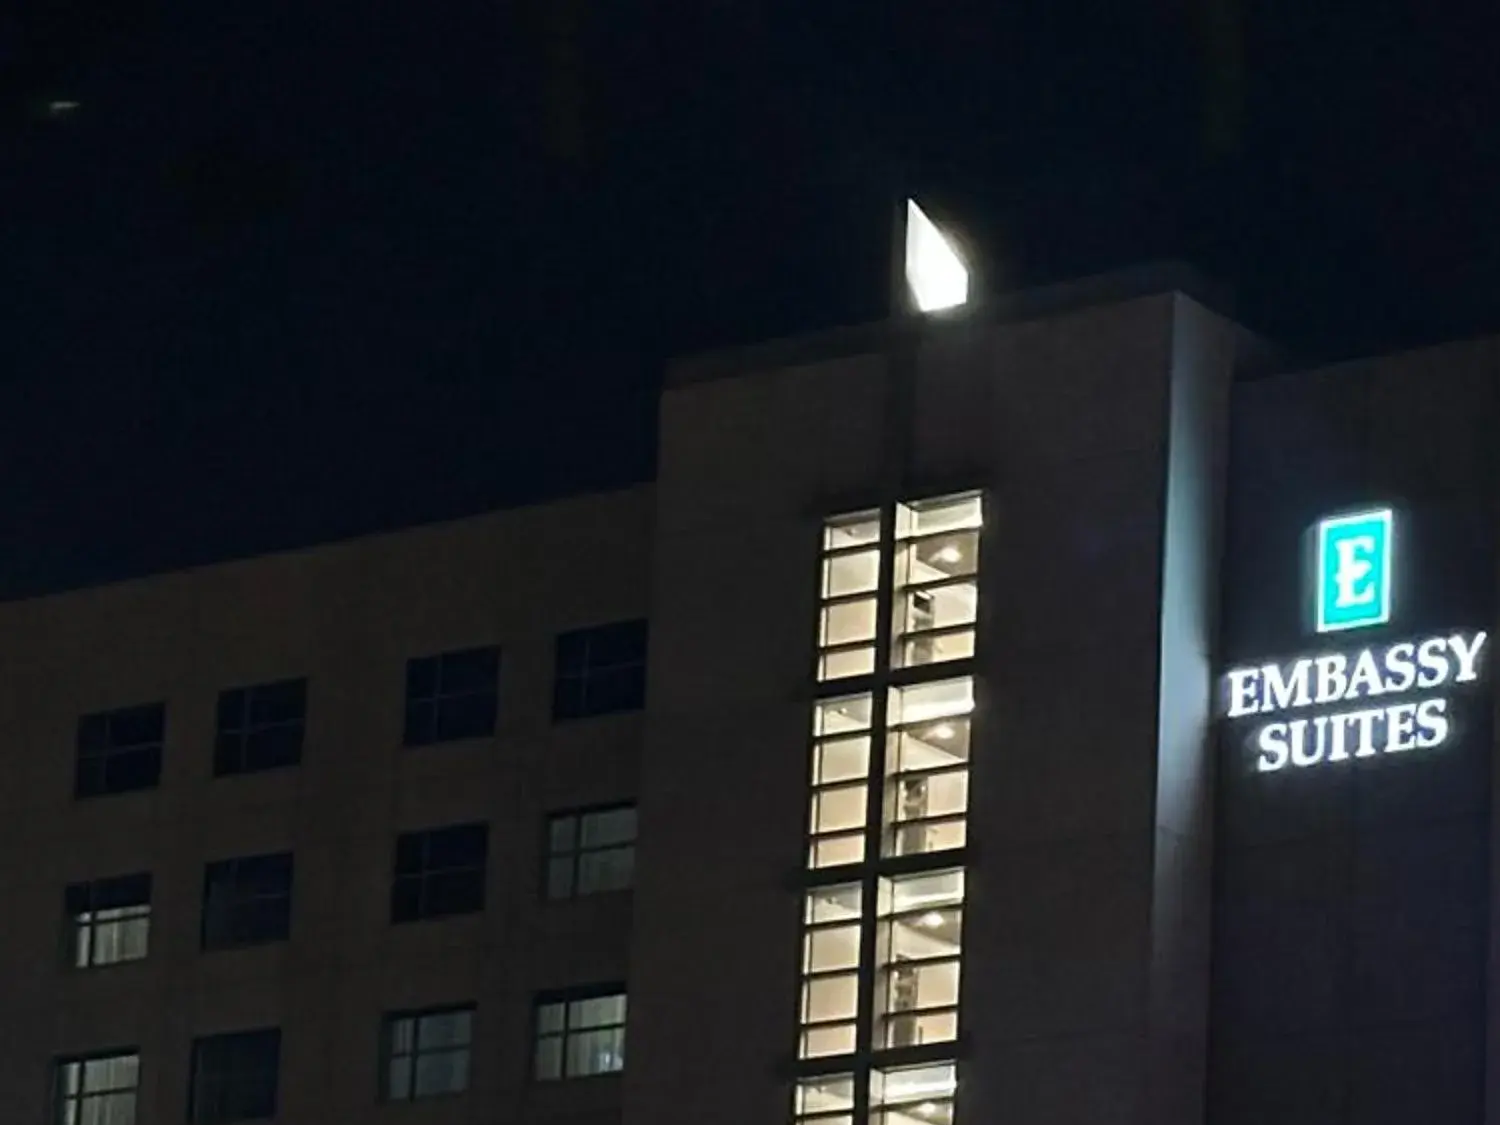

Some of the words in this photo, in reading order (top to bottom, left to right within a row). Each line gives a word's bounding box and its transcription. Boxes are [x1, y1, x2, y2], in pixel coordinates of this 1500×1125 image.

[1335, 535, 1375, 608] E
[1227, 631, 1487, 717] EMBASSY
[1257, 699, 1448, 772] SUITES
